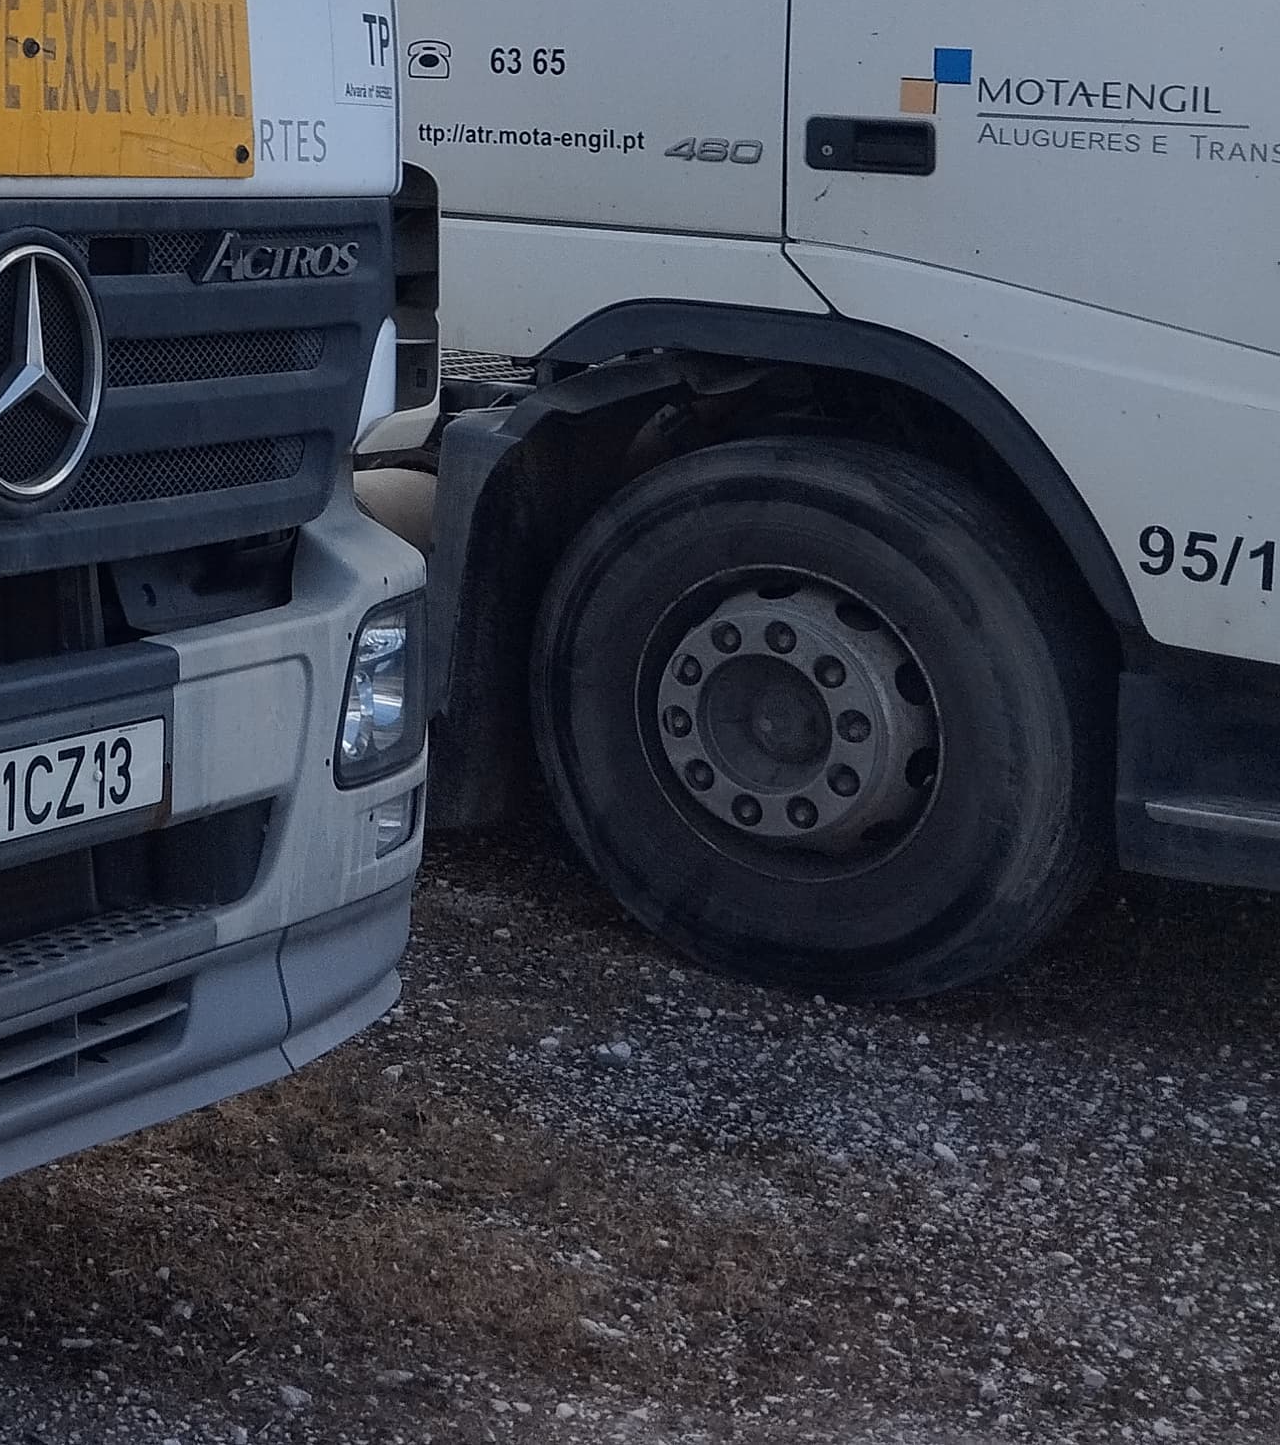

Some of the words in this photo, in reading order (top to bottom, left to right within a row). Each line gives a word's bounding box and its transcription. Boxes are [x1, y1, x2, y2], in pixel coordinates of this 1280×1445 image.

[362, 12, 391, 67] TP
[490, 47, 523, 75] 63
[532, 47, 566, 75] 65
[419, 123, 646, 154] ttp://atr.mota-engil.pt
[977, 122, 1141, 153] ALUGUERES
[1151, 135, 1168, 154] E
[1139, 524, 1276, 592] 95/1
